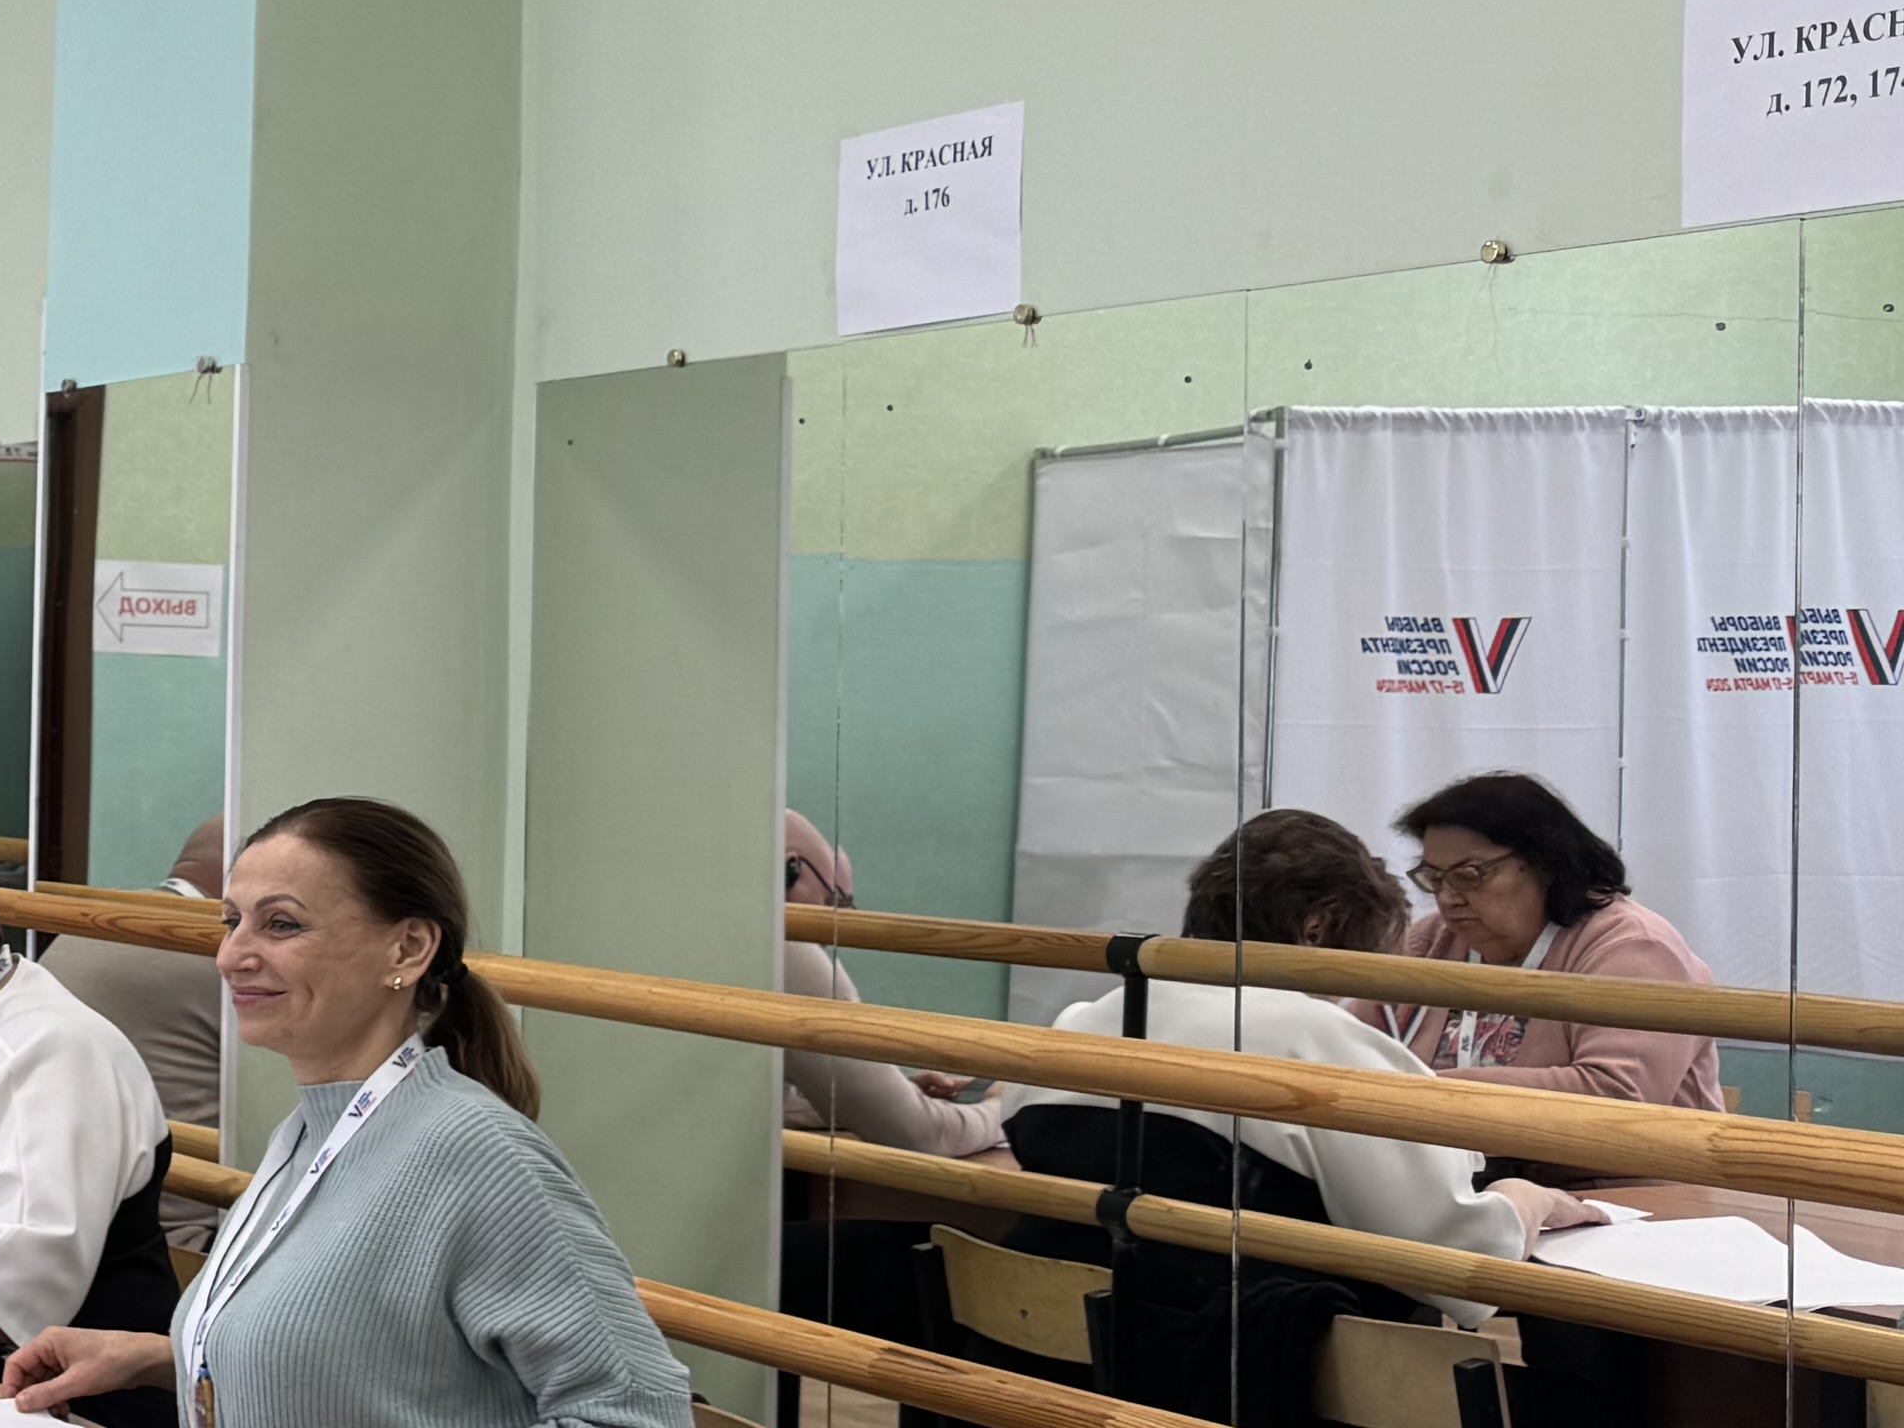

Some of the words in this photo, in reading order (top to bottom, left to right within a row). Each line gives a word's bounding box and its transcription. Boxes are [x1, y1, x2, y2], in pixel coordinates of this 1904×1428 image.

[1731, 29, 1785, 64] УЛ.
[1766, 91, 1791, 118] д.
[1802, 74, 1859, 108] 172,
[1868, 66, 1904, 99] 17
[866, 155, 896, 181] УЛ.
[901, 135, 994, 174] КРАСНАЯ
[904, 198, 918, 216] д.
[923, 185, 951, 211] 176
